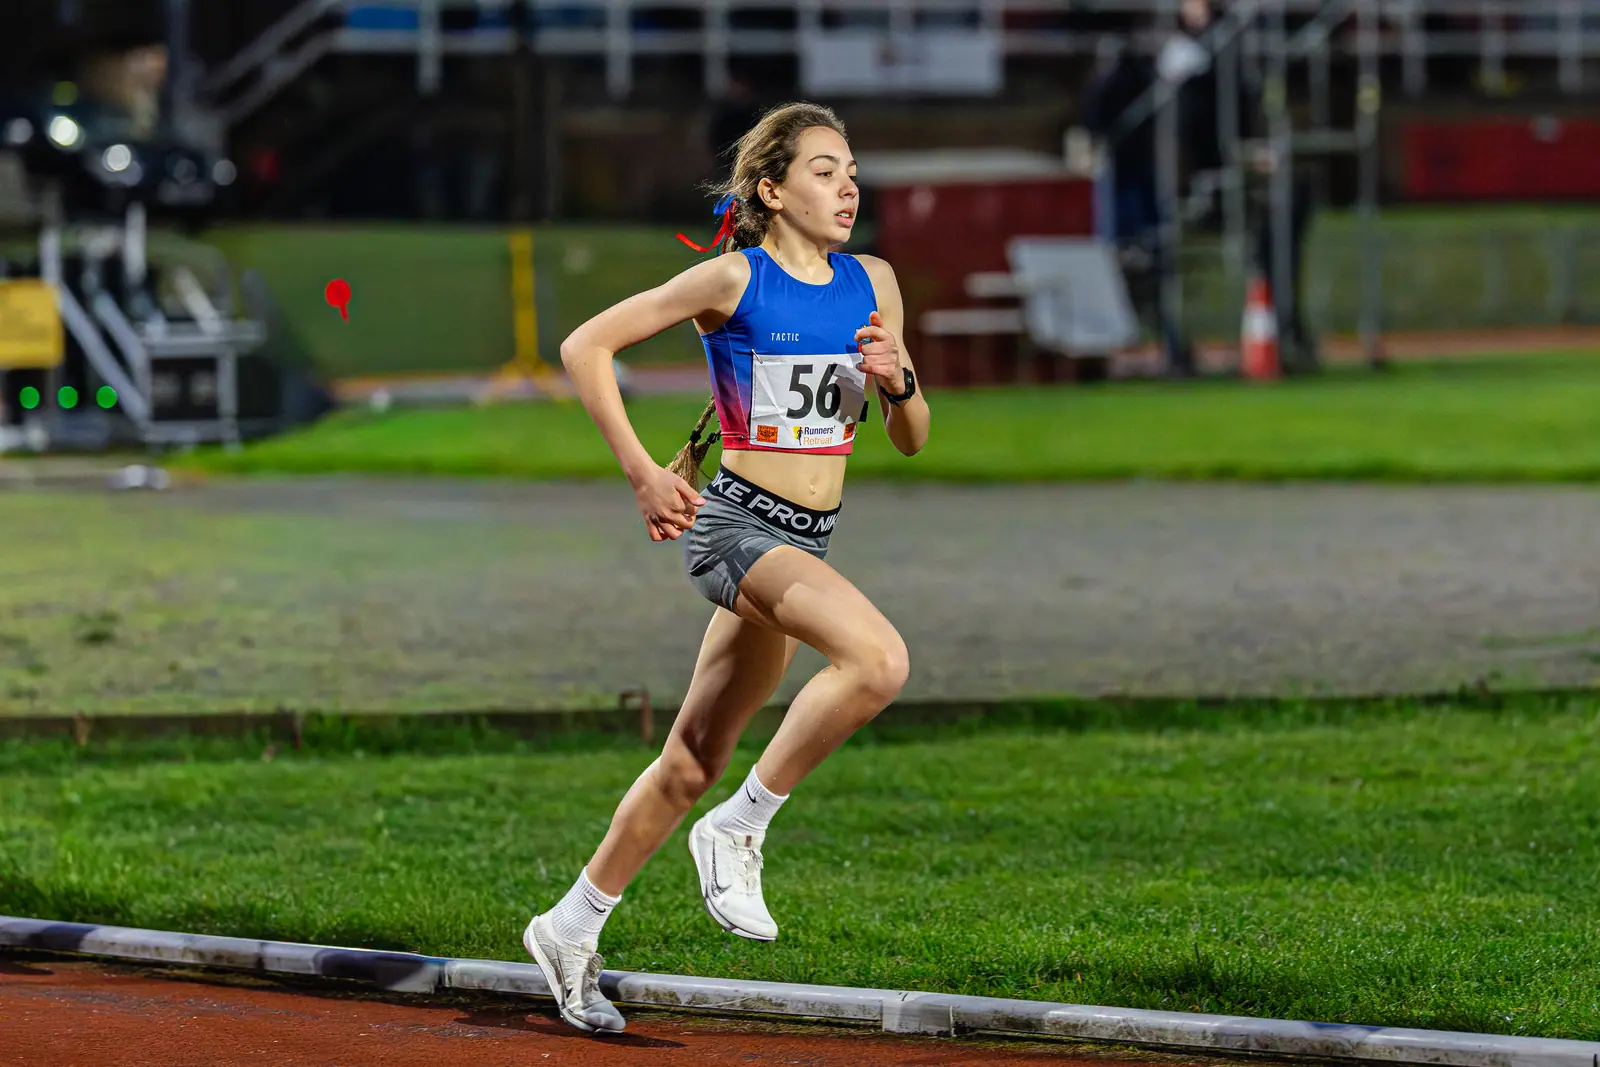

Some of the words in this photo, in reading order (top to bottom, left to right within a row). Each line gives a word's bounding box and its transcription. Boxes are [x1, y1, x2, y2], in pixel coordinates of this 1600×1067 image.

[771, 332, 799, 342] TACTIC
[786, 363, 841, 419] 56
[804, 425, 836, 435] Runners'
[803, 436, 832, 445] Retreat
[747, 493, 812, 530] PRO
